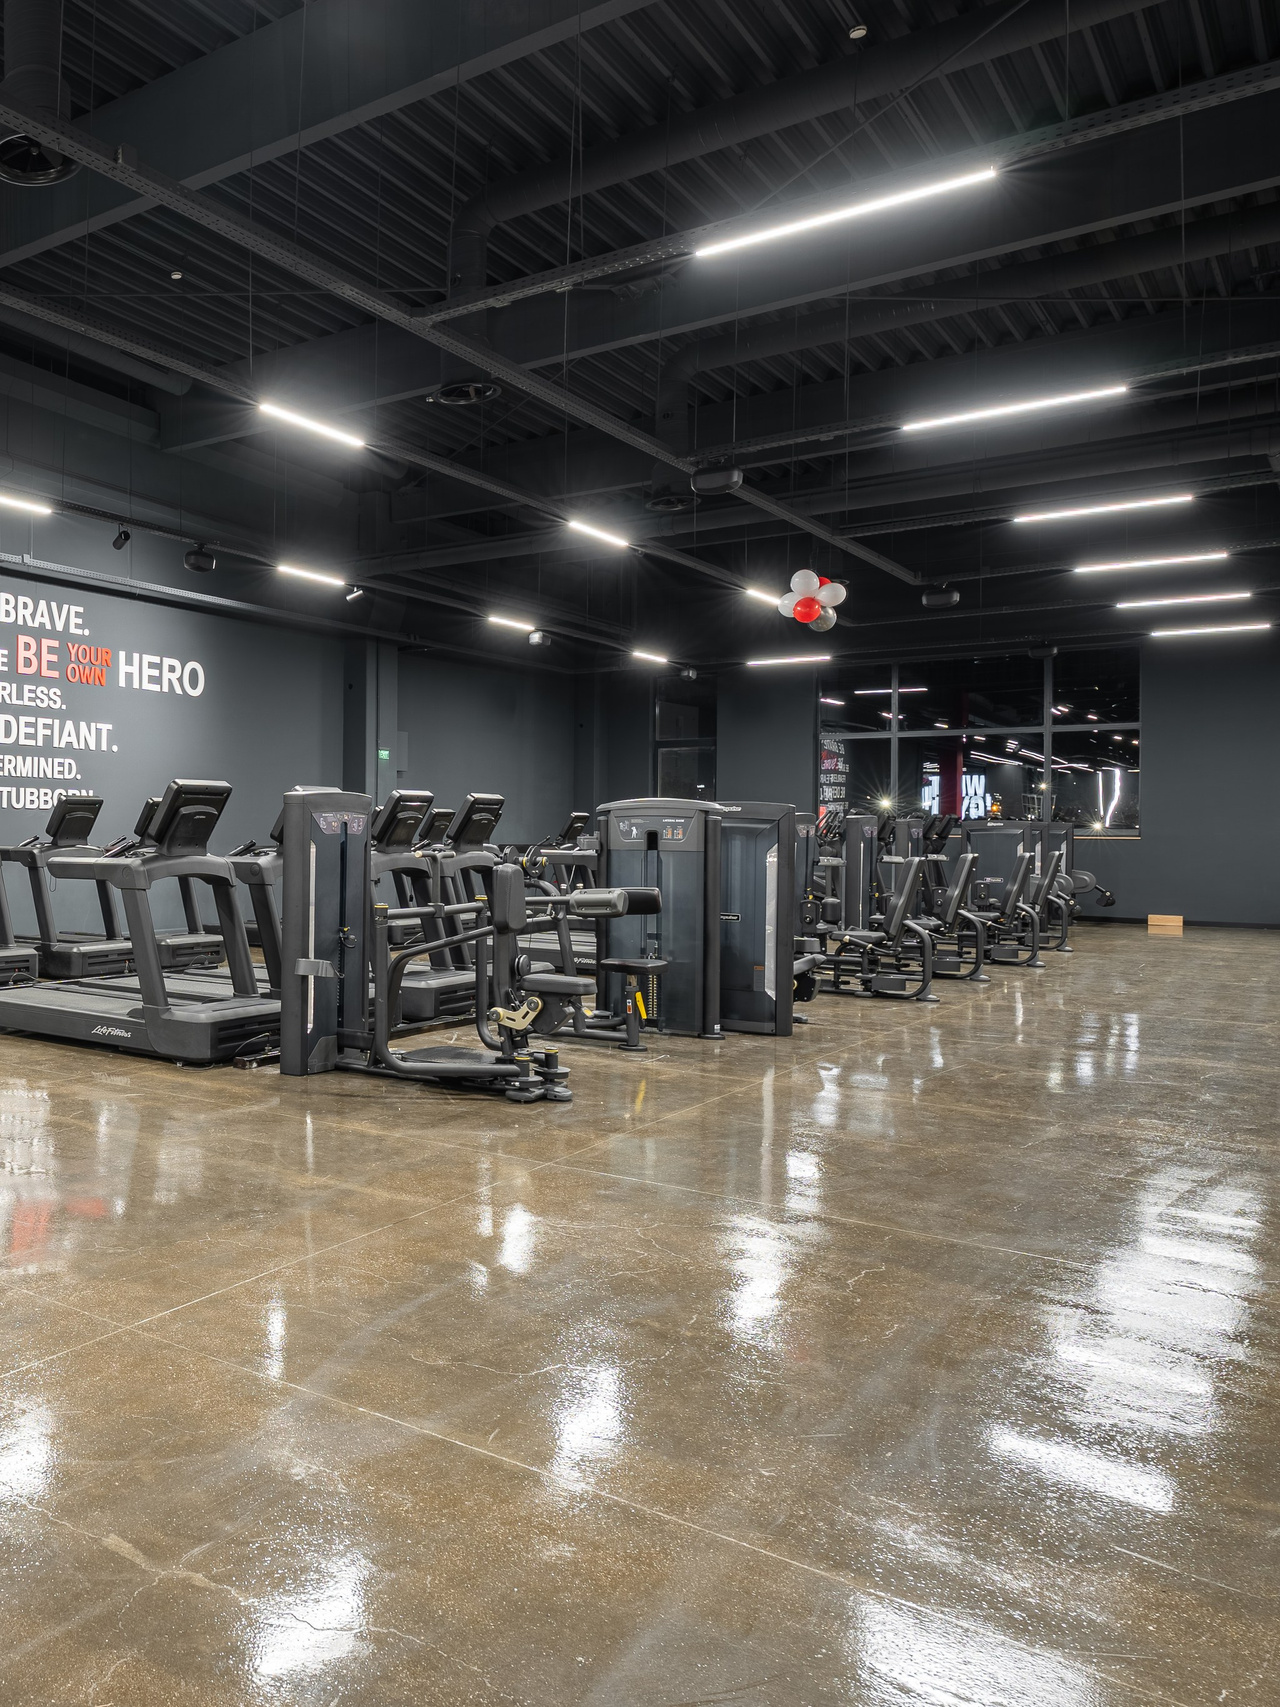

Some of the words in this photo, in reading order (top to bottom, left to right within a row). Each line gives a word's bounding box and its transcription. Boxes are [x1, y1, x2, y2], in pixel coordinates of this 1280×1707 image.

[0, 592, 90, 636] BRAVE.
[16, 634, 60, 678] BE
[66, 642, 112, 668] YOUR
[118, 650, 205, 697] HERO
[66, 663, 106, 686] OWN
